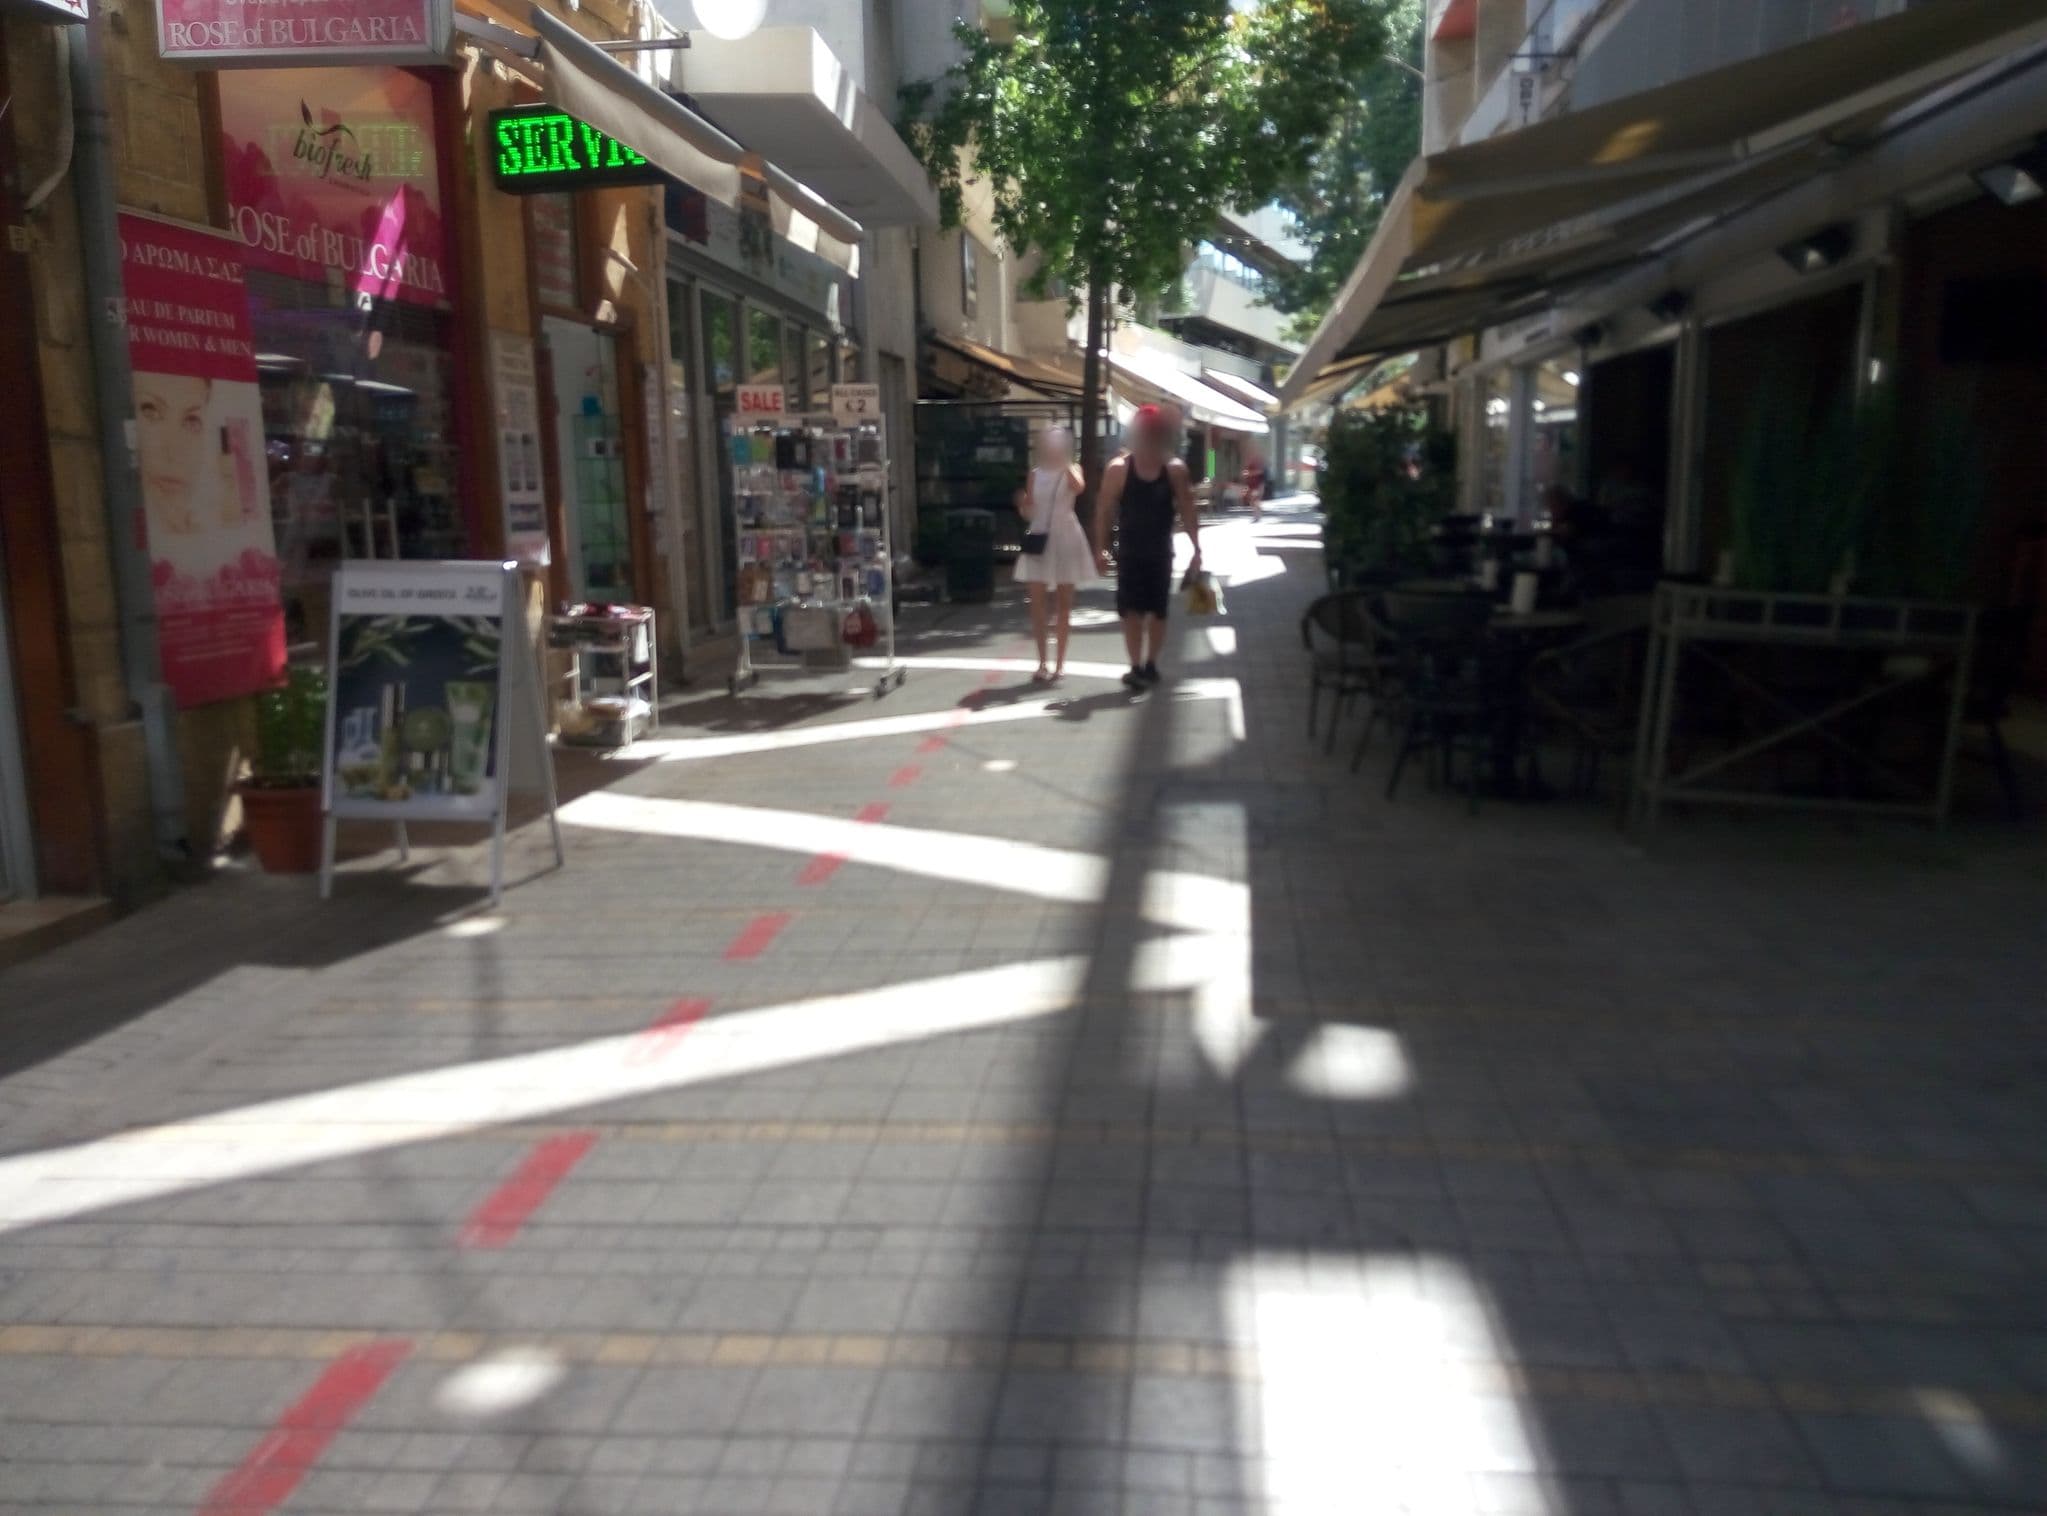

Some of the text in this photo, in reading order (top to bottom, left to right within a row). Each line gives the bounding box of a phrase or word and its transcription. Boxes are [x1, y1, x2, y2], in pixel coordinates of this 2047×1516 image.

[168, 16, 422, 48] ROSE of BULGARIA
[293, 128, 373, 183] biofresh
[296, 222, 319, 262] of
[321, 228, 445, 294] BULGARIA
[154, 301, 174, 321] DE
[178, 305, 236, 331] PARFUM
[143, 326, 201, 351] WOMEN
[205, 335, 217, 353] &
[741, 391, 782, 412] SALE
